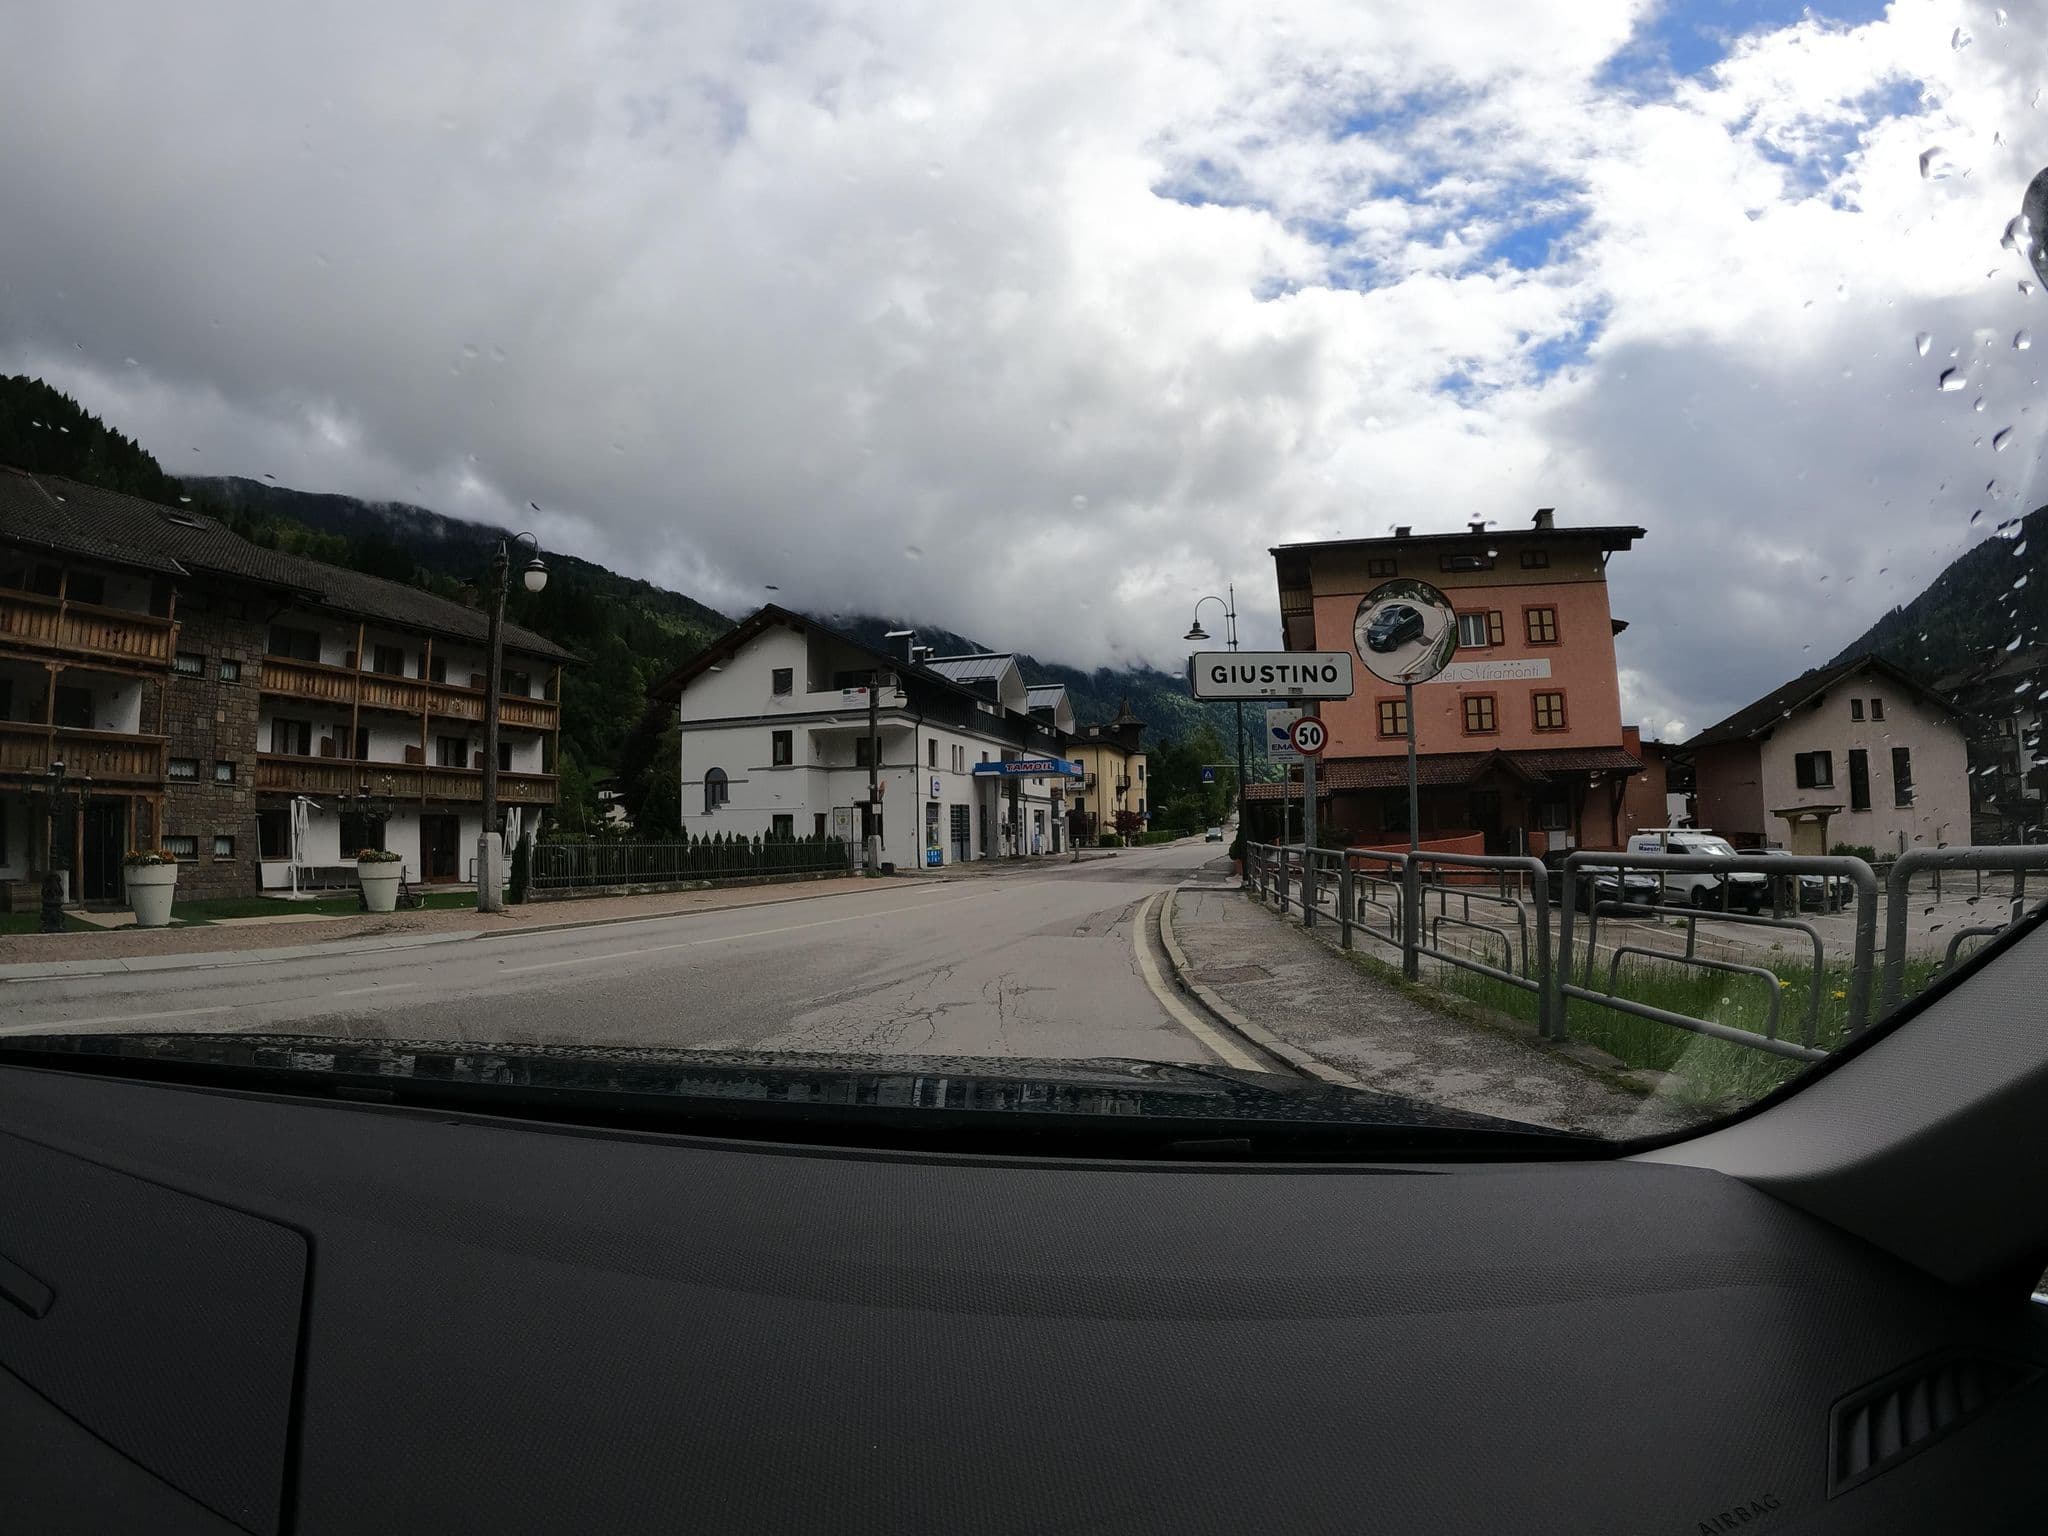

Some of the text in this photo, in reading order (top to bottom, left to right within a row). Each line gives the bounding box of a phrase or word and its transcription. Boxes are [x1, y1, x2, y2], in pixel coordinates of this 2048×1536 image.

[1211, 665, 1338, 684] GIUSTINO
[1298, 727, 1321, 745] 50
[1271, 743, 1295, 751] EMA
[1005, 762, 1055, 772] TAMOIL
[1698, 1493, 1780, 1536] AIRBAG
